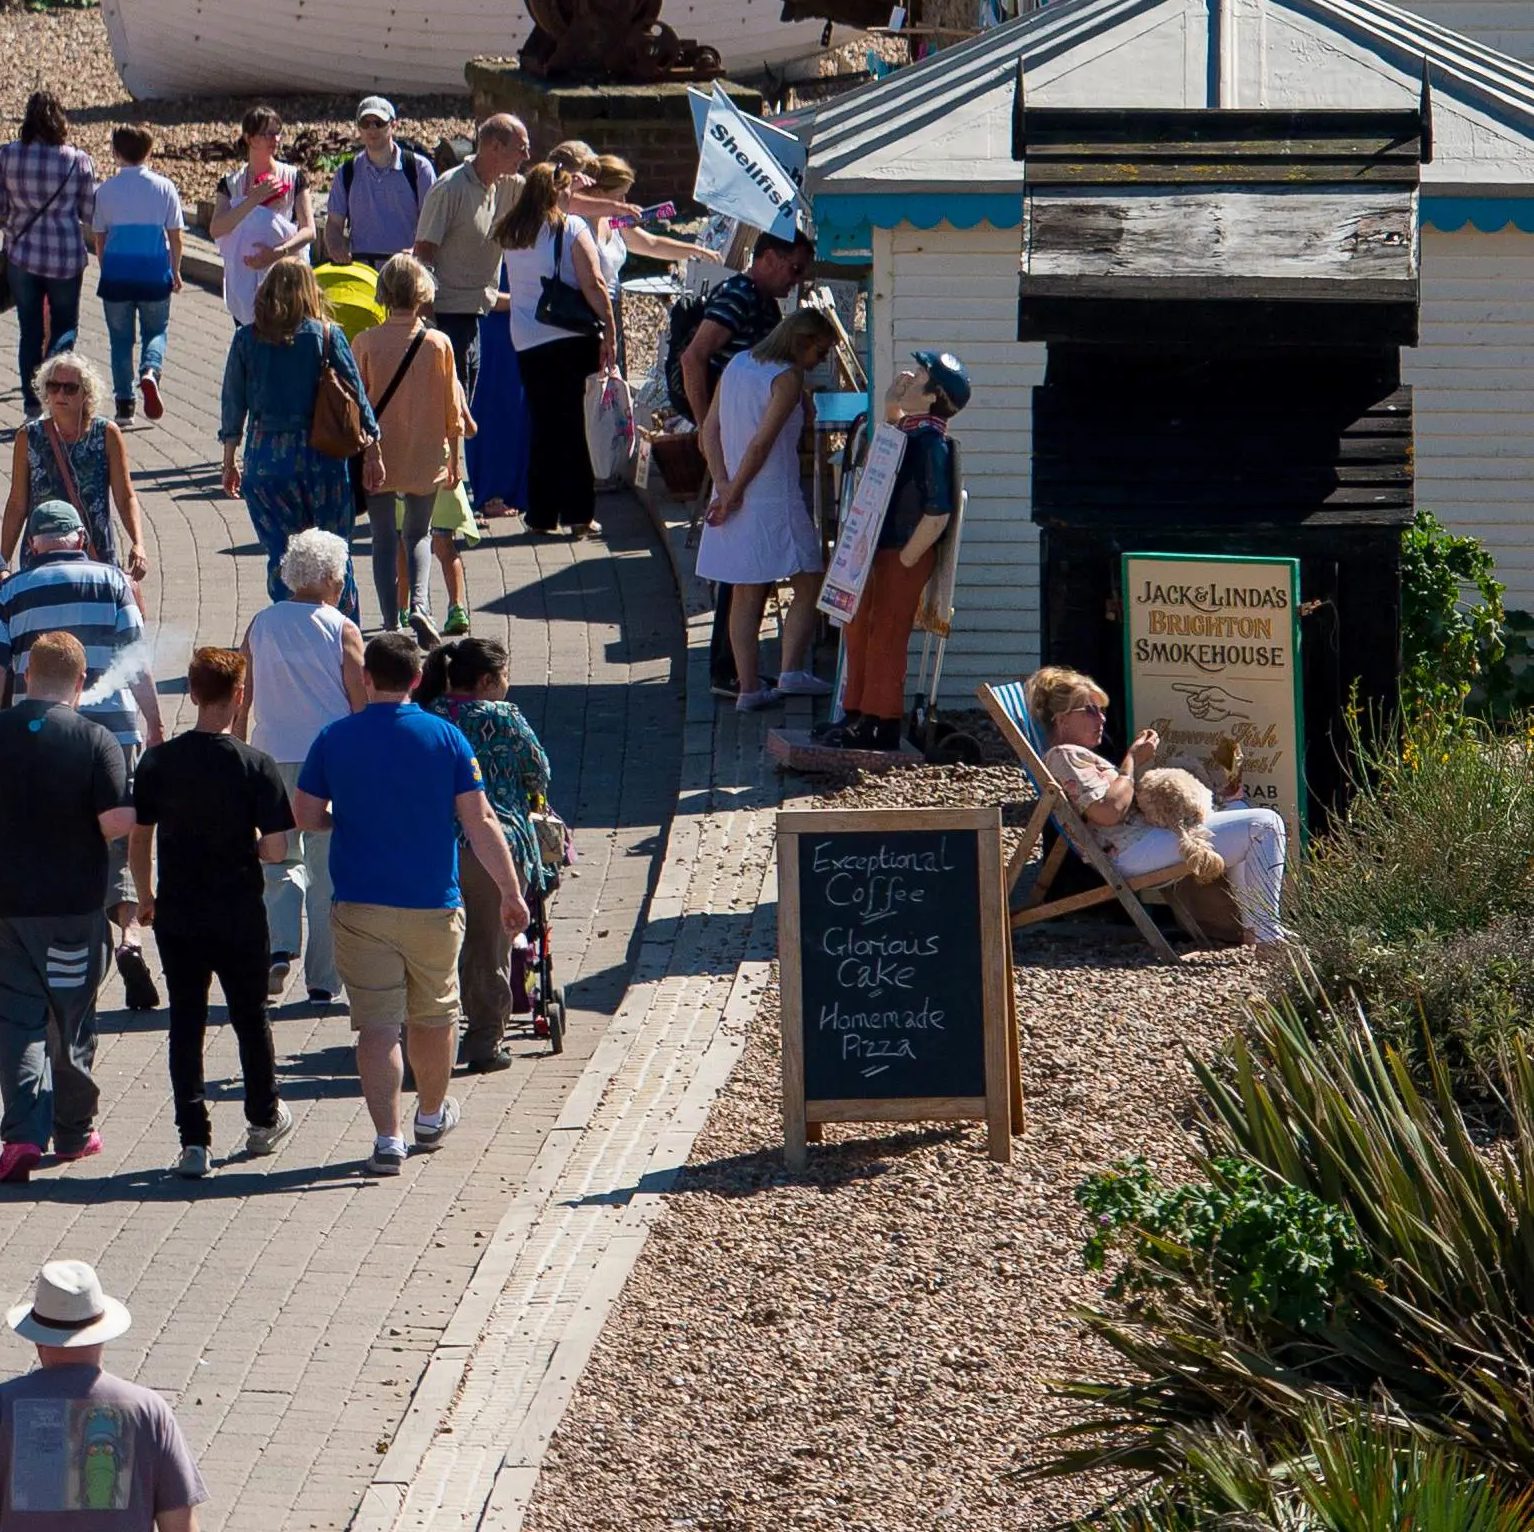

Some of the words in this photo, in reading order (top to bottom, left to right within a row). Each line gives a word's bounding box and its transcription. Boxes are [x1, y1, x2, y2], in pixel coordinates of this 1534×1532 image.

[710, 123, 794, 219] Shellfish
[1149, 610, 1272, 640] BRIGHTON
[1136, 638, 1285, 673] SMOKEHOUSE
[813, 836, 955, 878] Exceptional
[826, 872, 925, 917] Coffee
[823, 927, 940, 956] Glorious
[837, 957, 916, 988] Cake
[819, 997, 945, 1030] Homemade
[843, 1033, 917, 1059] Pizza
